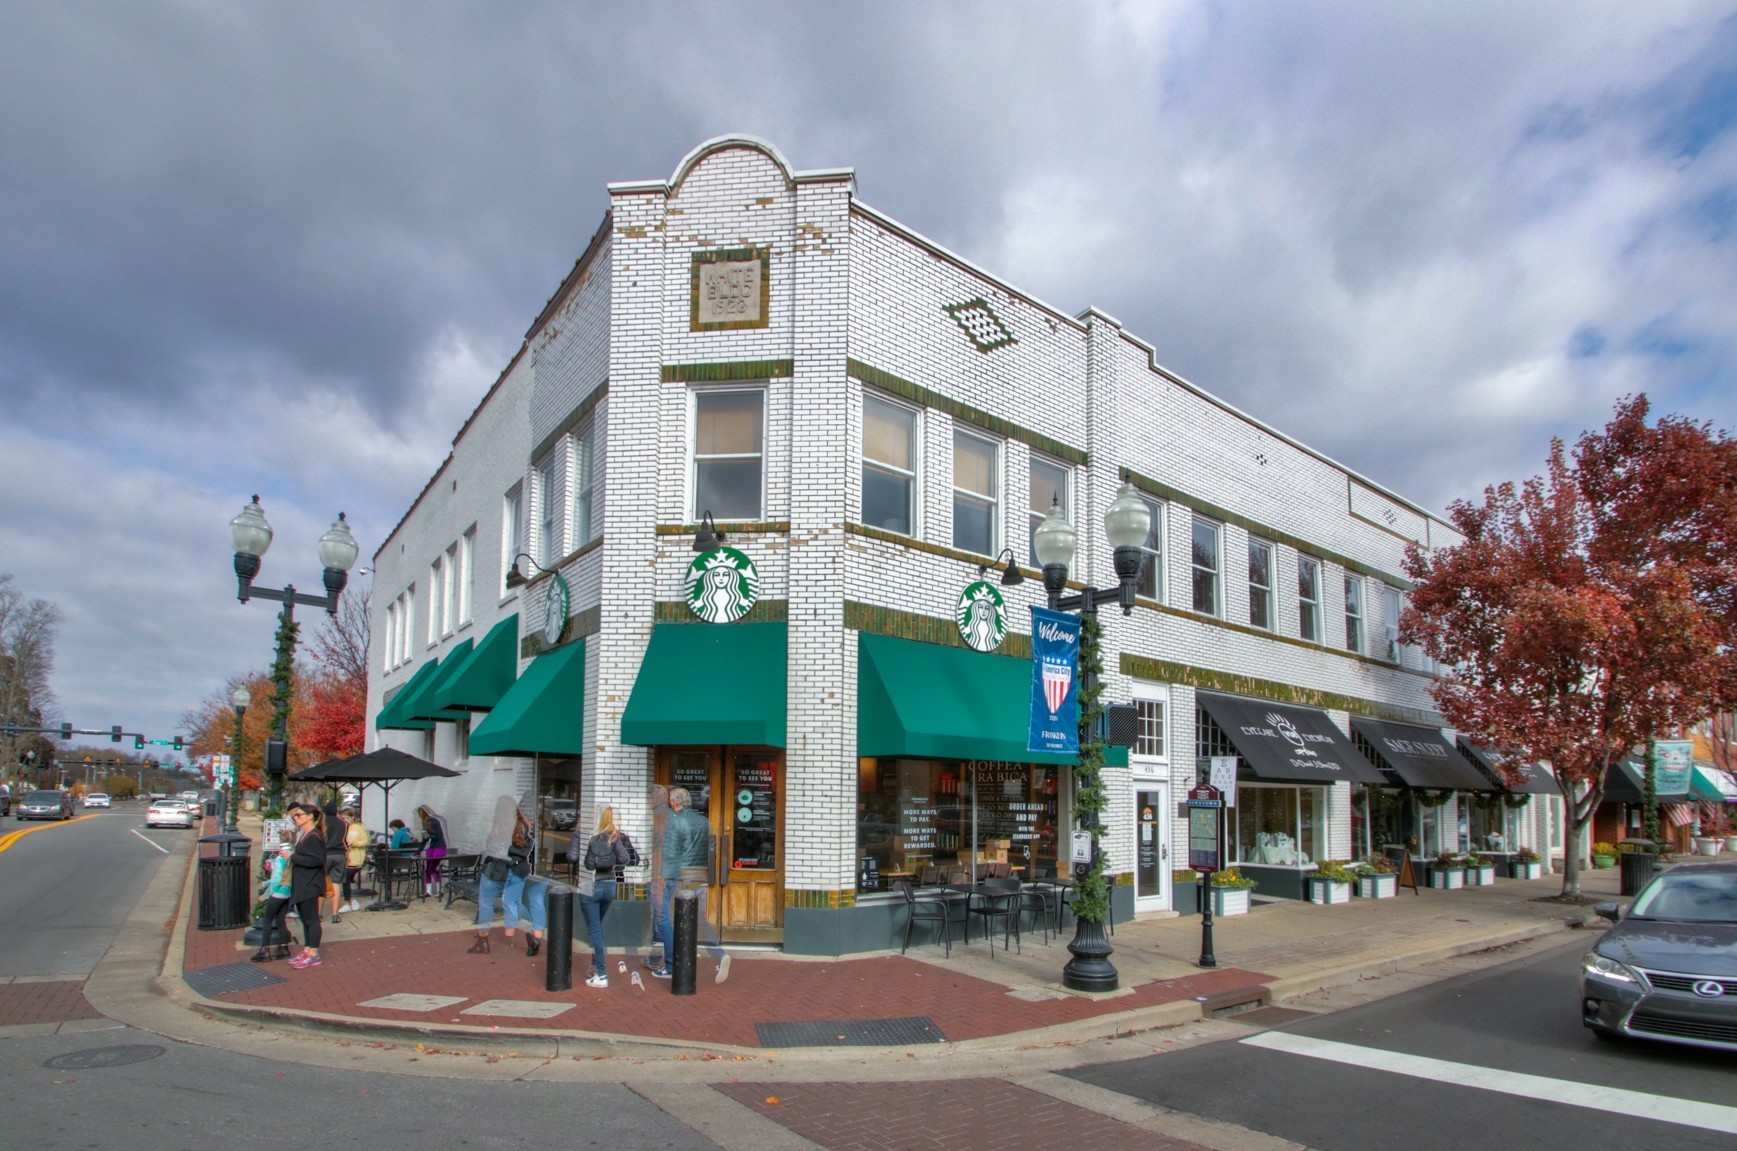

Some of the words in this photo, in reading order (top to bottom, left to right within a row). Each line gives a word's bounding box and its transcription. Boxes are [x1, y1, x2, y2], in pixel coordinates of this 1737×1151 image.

[708, 284, 751, 300] BLDG
[1038, 621, 1075, 644] Welcome
[1240, 726, 1279, 738] EYECARE
[1144, 766, 1154, 774] 436
[1009, 803, 1026, 811] ORDER
